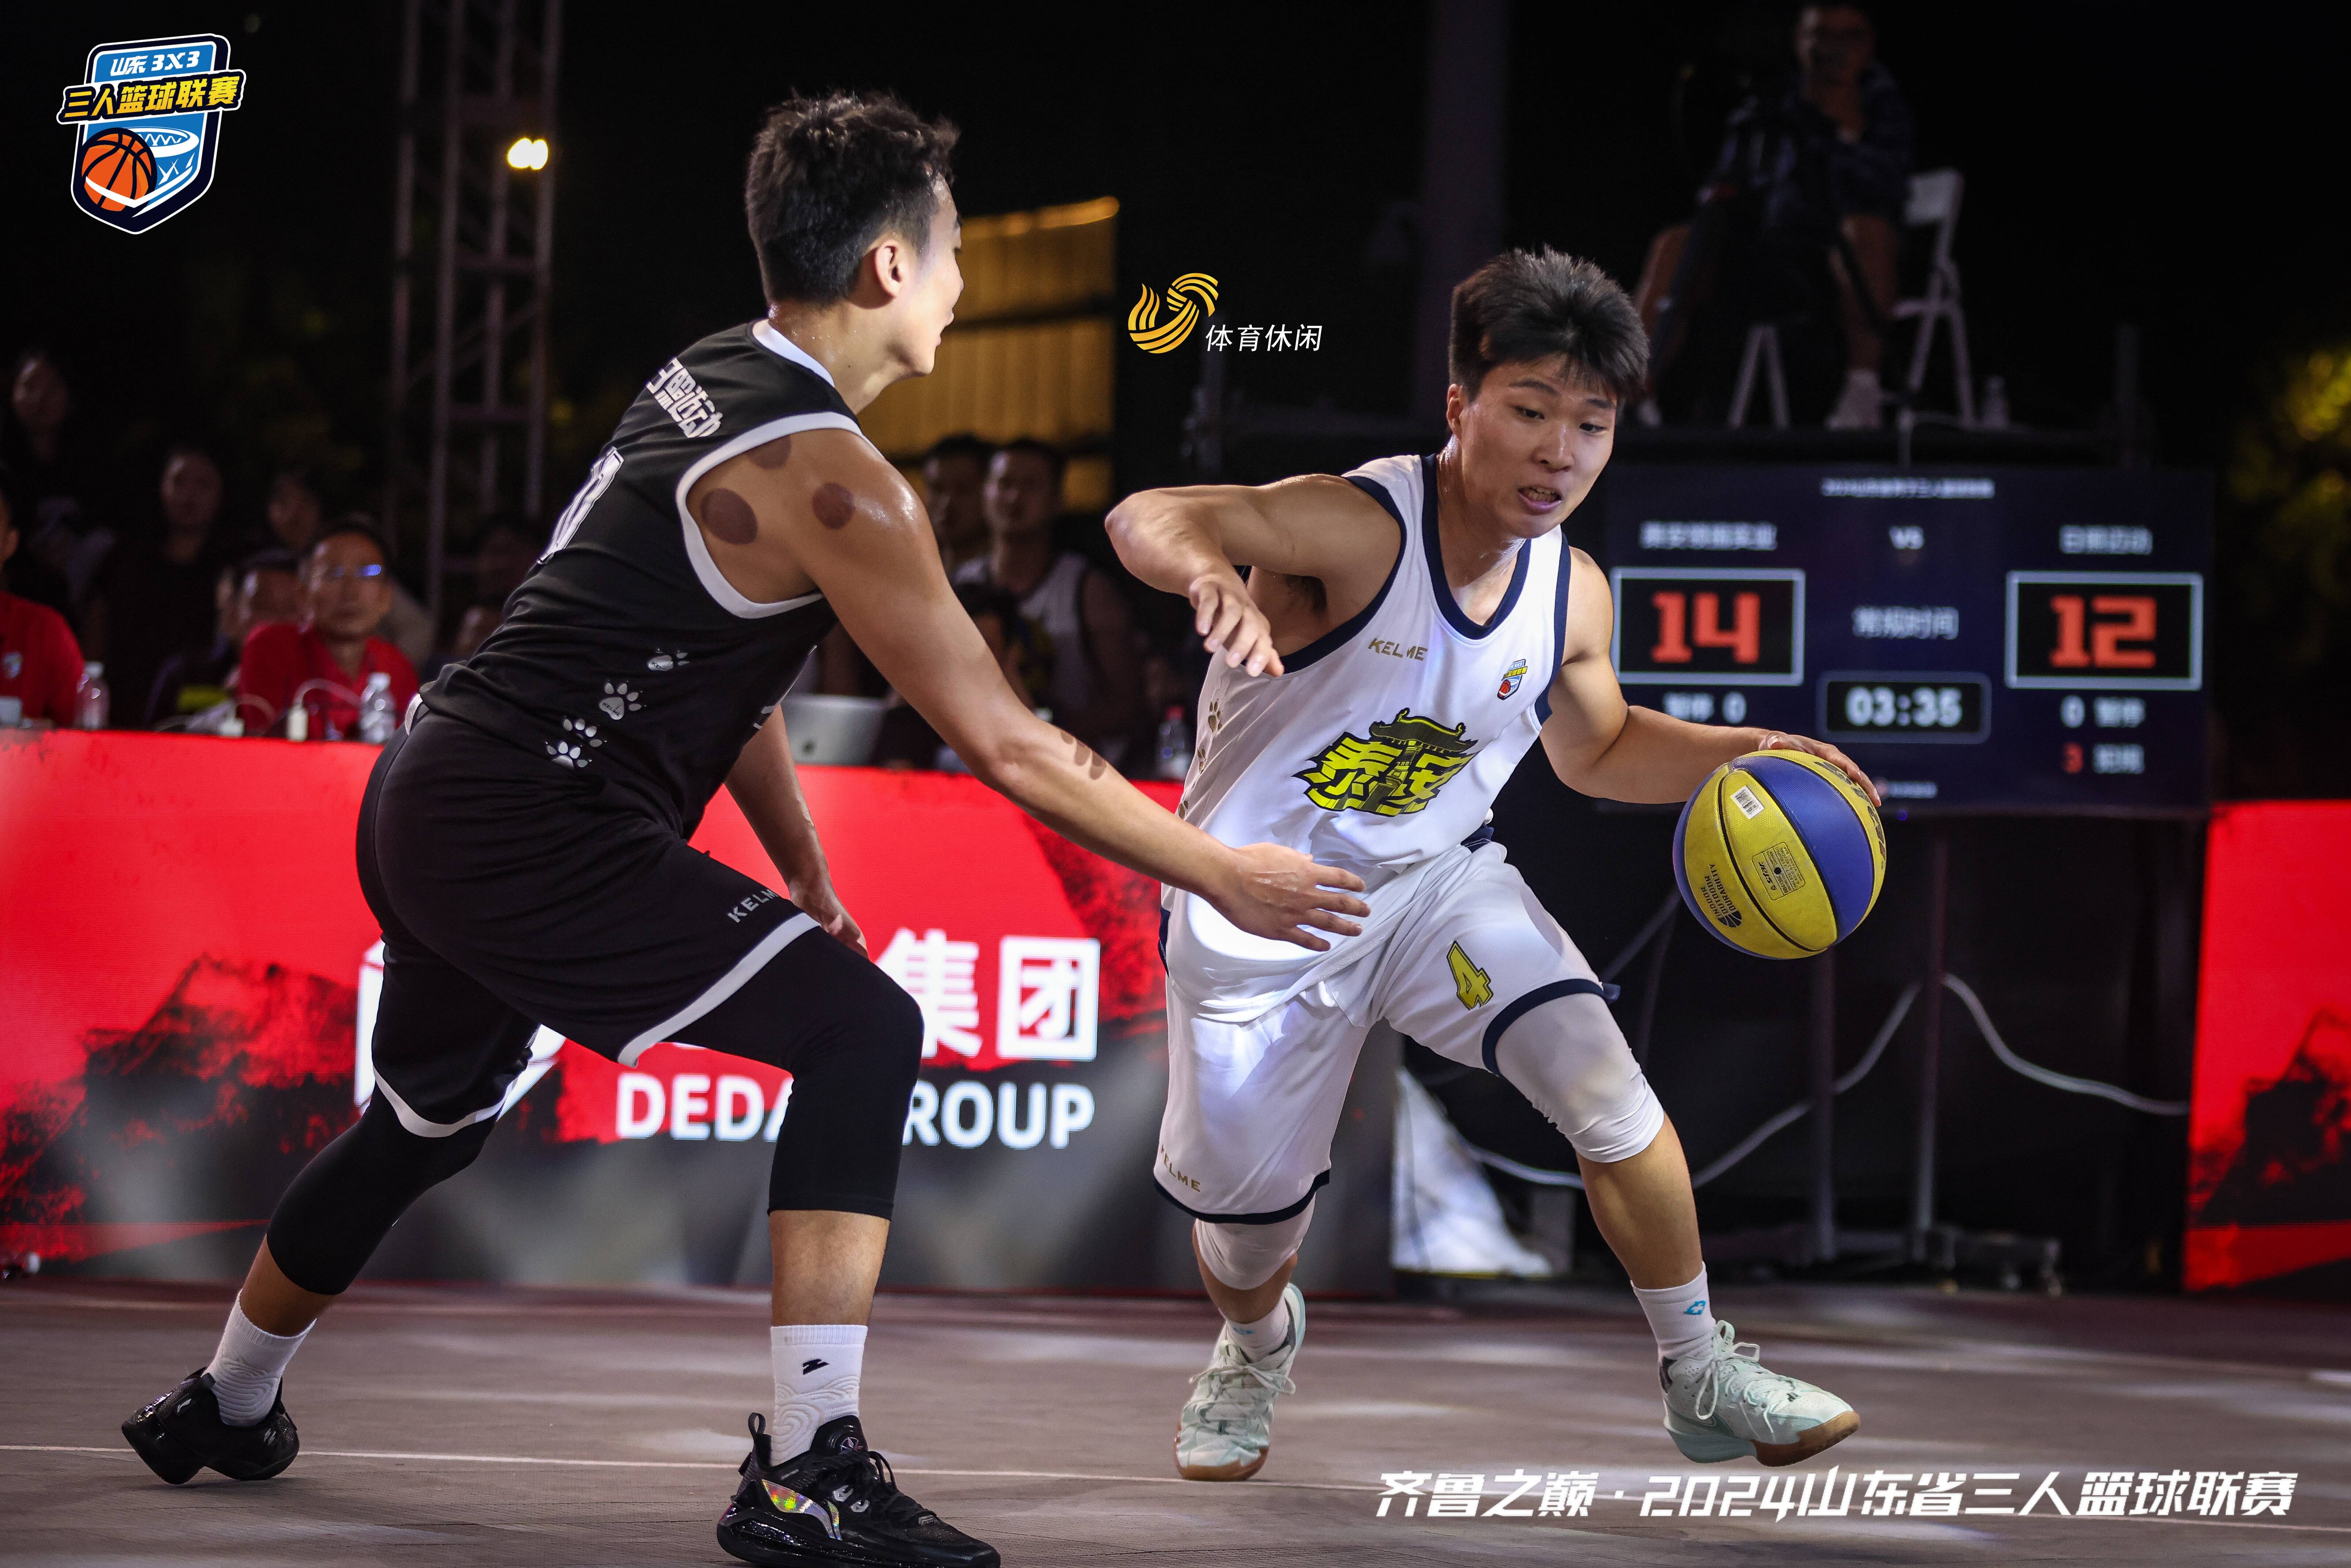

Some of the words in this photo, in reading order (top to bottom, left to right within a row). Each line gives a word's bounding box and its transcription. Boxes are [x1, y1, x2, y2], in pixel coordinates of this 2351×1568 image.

[1651, 590, 1761, 664] 14
[2050, 594, 2157, 669] 12
[1723, 691, 1747, 724] 0
[1845, 686, 1962, 727] 03:35
[2060, 695, 2085, 728] 0
[2061, 742, 2083, 774] 3
[727, 889, 779, 923] KELM
[1701, 887, 1720, 917] INDOOR
[1704, 876, 1728, 915] OUTDOOR
[1709, 864, 1735, 913] DURABILITY
[1447, 941, 1493, 1010] 4
[902, 1079, 1096, 1149] ROUP
